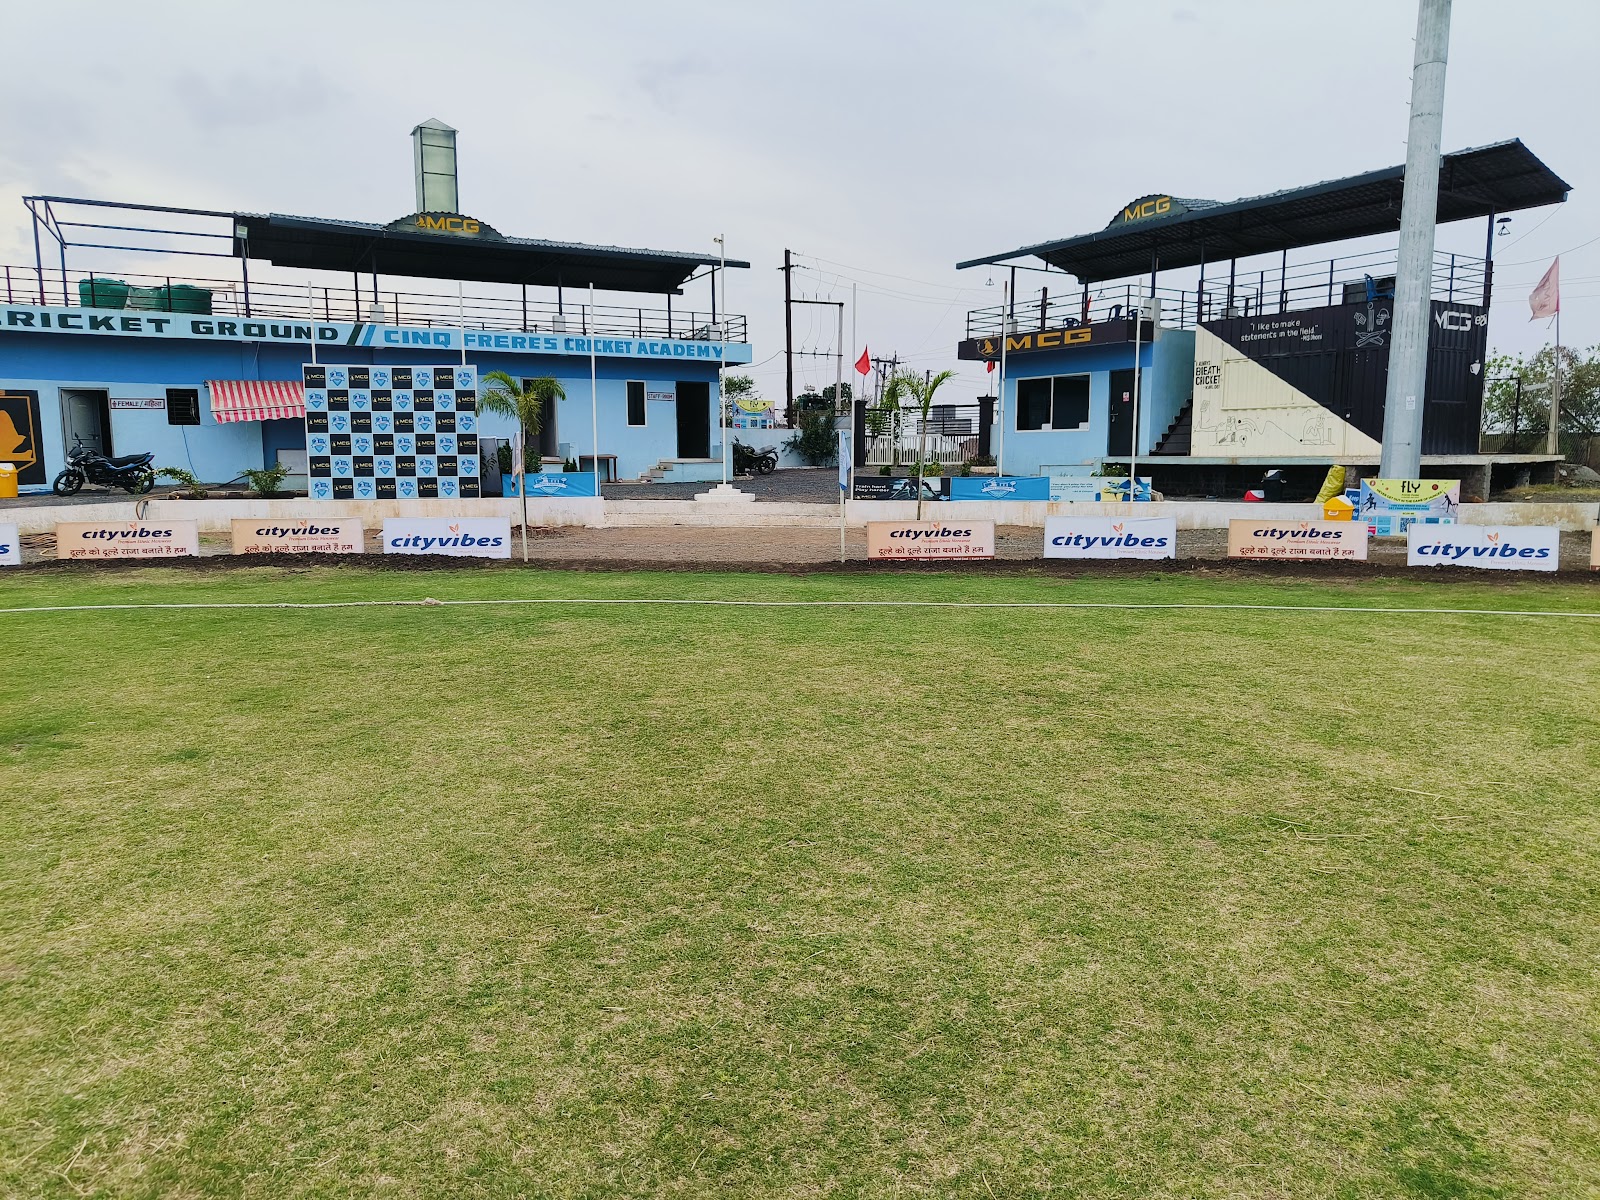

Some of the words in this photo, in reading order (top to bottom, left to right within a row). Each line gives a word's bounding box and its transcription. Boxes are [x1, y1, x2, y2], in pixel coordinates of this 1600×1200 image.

[1124, 197, 1170, 222] MCG
[426, 215, 480, 233] MCG
[0, 310, 171, 333] RICKET
[190, 320, 339, 340] GROUND
[1280, 320, 1300, 328] make
[1435, 310, 1472, 331] MCG
[1005, 328, 1092, 351] MCG
[1241, 332, 1276, 341] statements
[384, 330, 451, 348] CINQ
[464, 333, 558, 350] FRERES
[564, 338, 632, 354] CRICKET
[637, 342, 726, 358] ACADEMY
[82, 527, 172, 541] cityvibes
[256, 525, 340, 538] cityvibes
[890, 528, 972, 540] cityvibes
[1253, 527, 1342, 540] cityvibes
[262, 544, 272, 552] को
[391, 534, 503, 550] cityvibes
[1052, 532, 1168, 550] cityvibes
[89, 547, 100, 555] को
[895, 546, 905, 554] को
[1257, 545, 1268, 554] को
[1417, 541, 1550, 560] cityvibes
